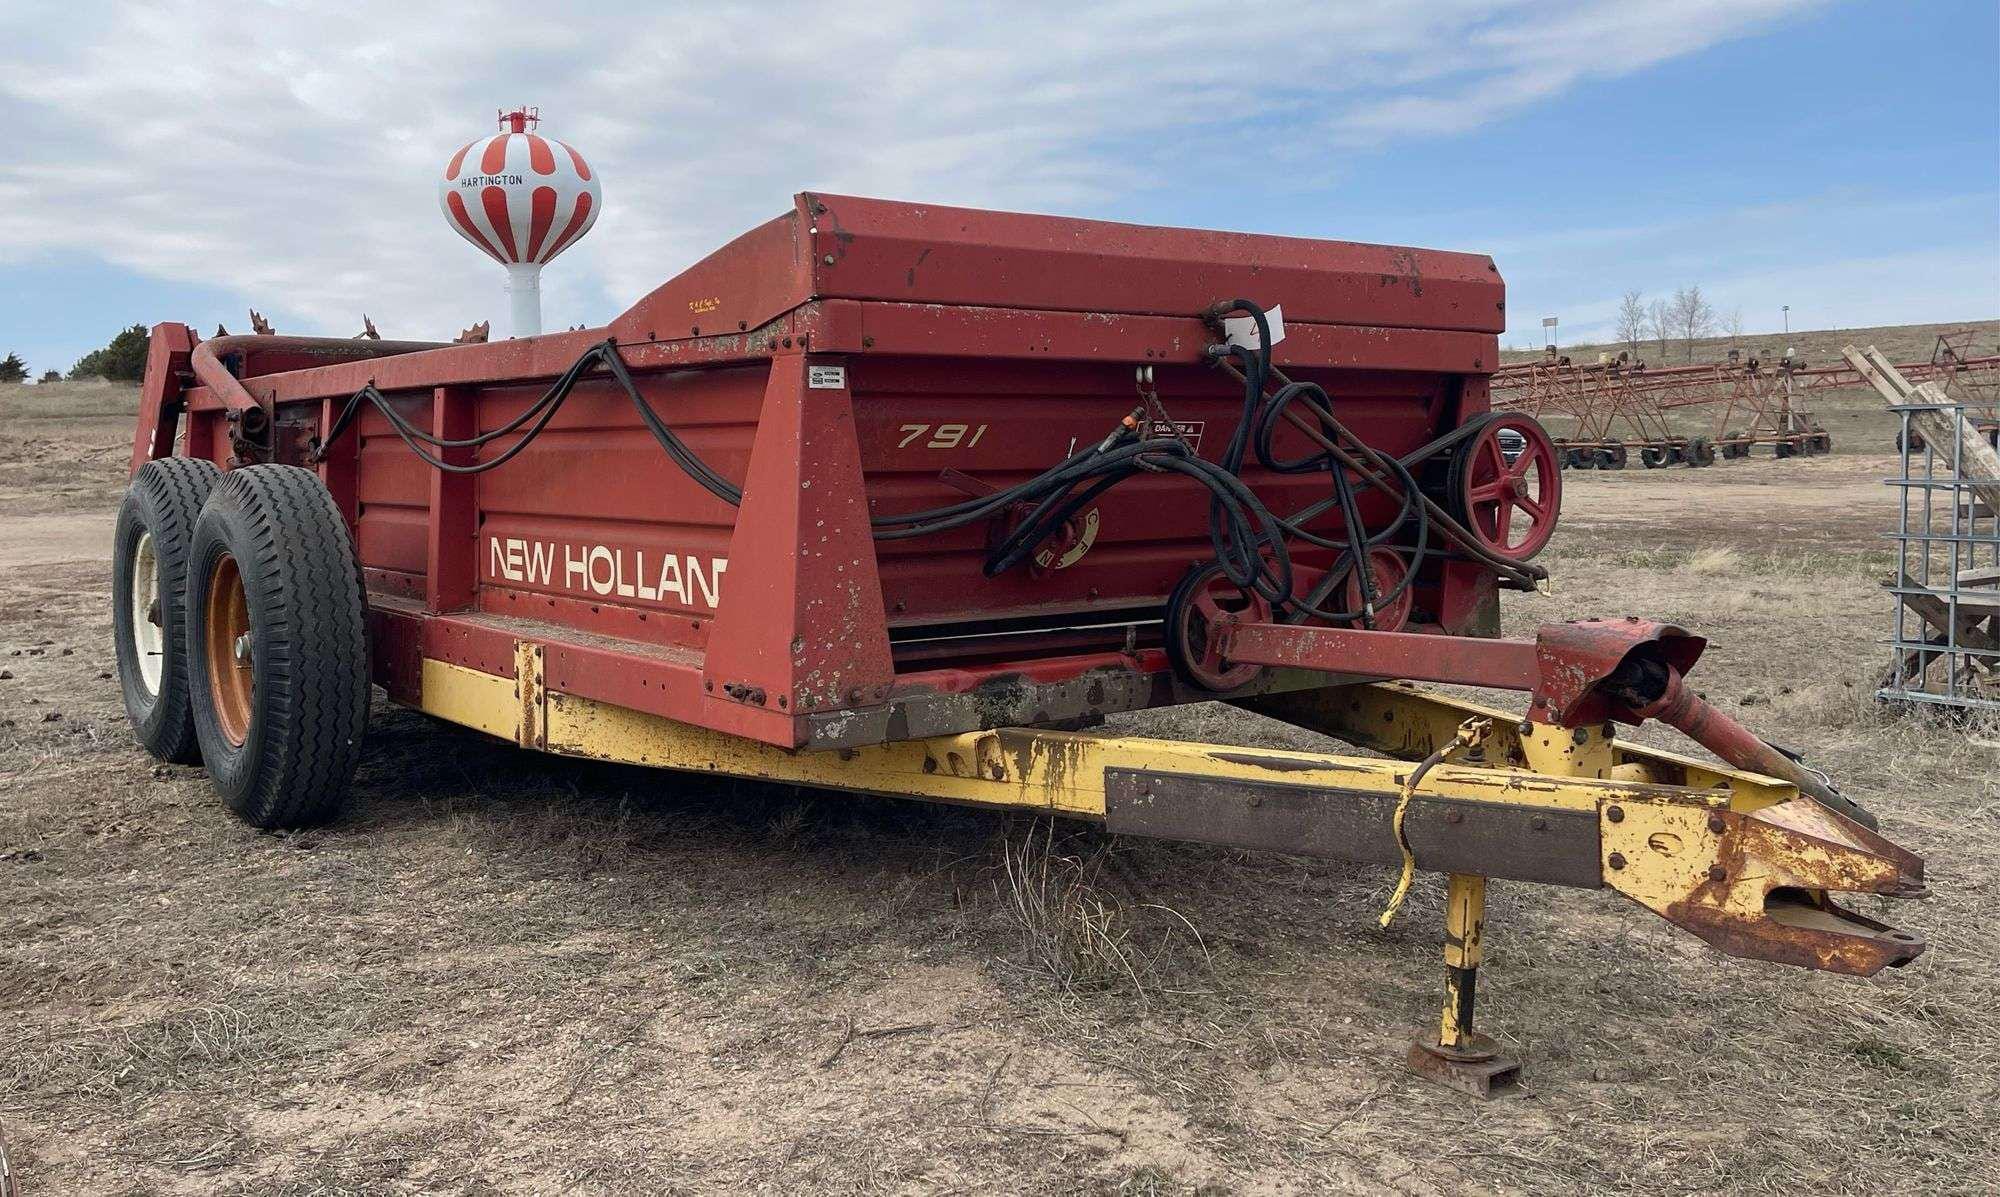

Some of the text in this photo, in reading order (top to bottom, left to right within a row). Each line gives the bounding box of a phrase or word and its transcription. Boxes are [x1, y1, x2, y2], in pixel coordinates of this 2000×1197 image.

[461, 175, 522, 188] HARTINGTON
[898, 424, 988, 448] 791
[490, 537, 555, 586] NEW
